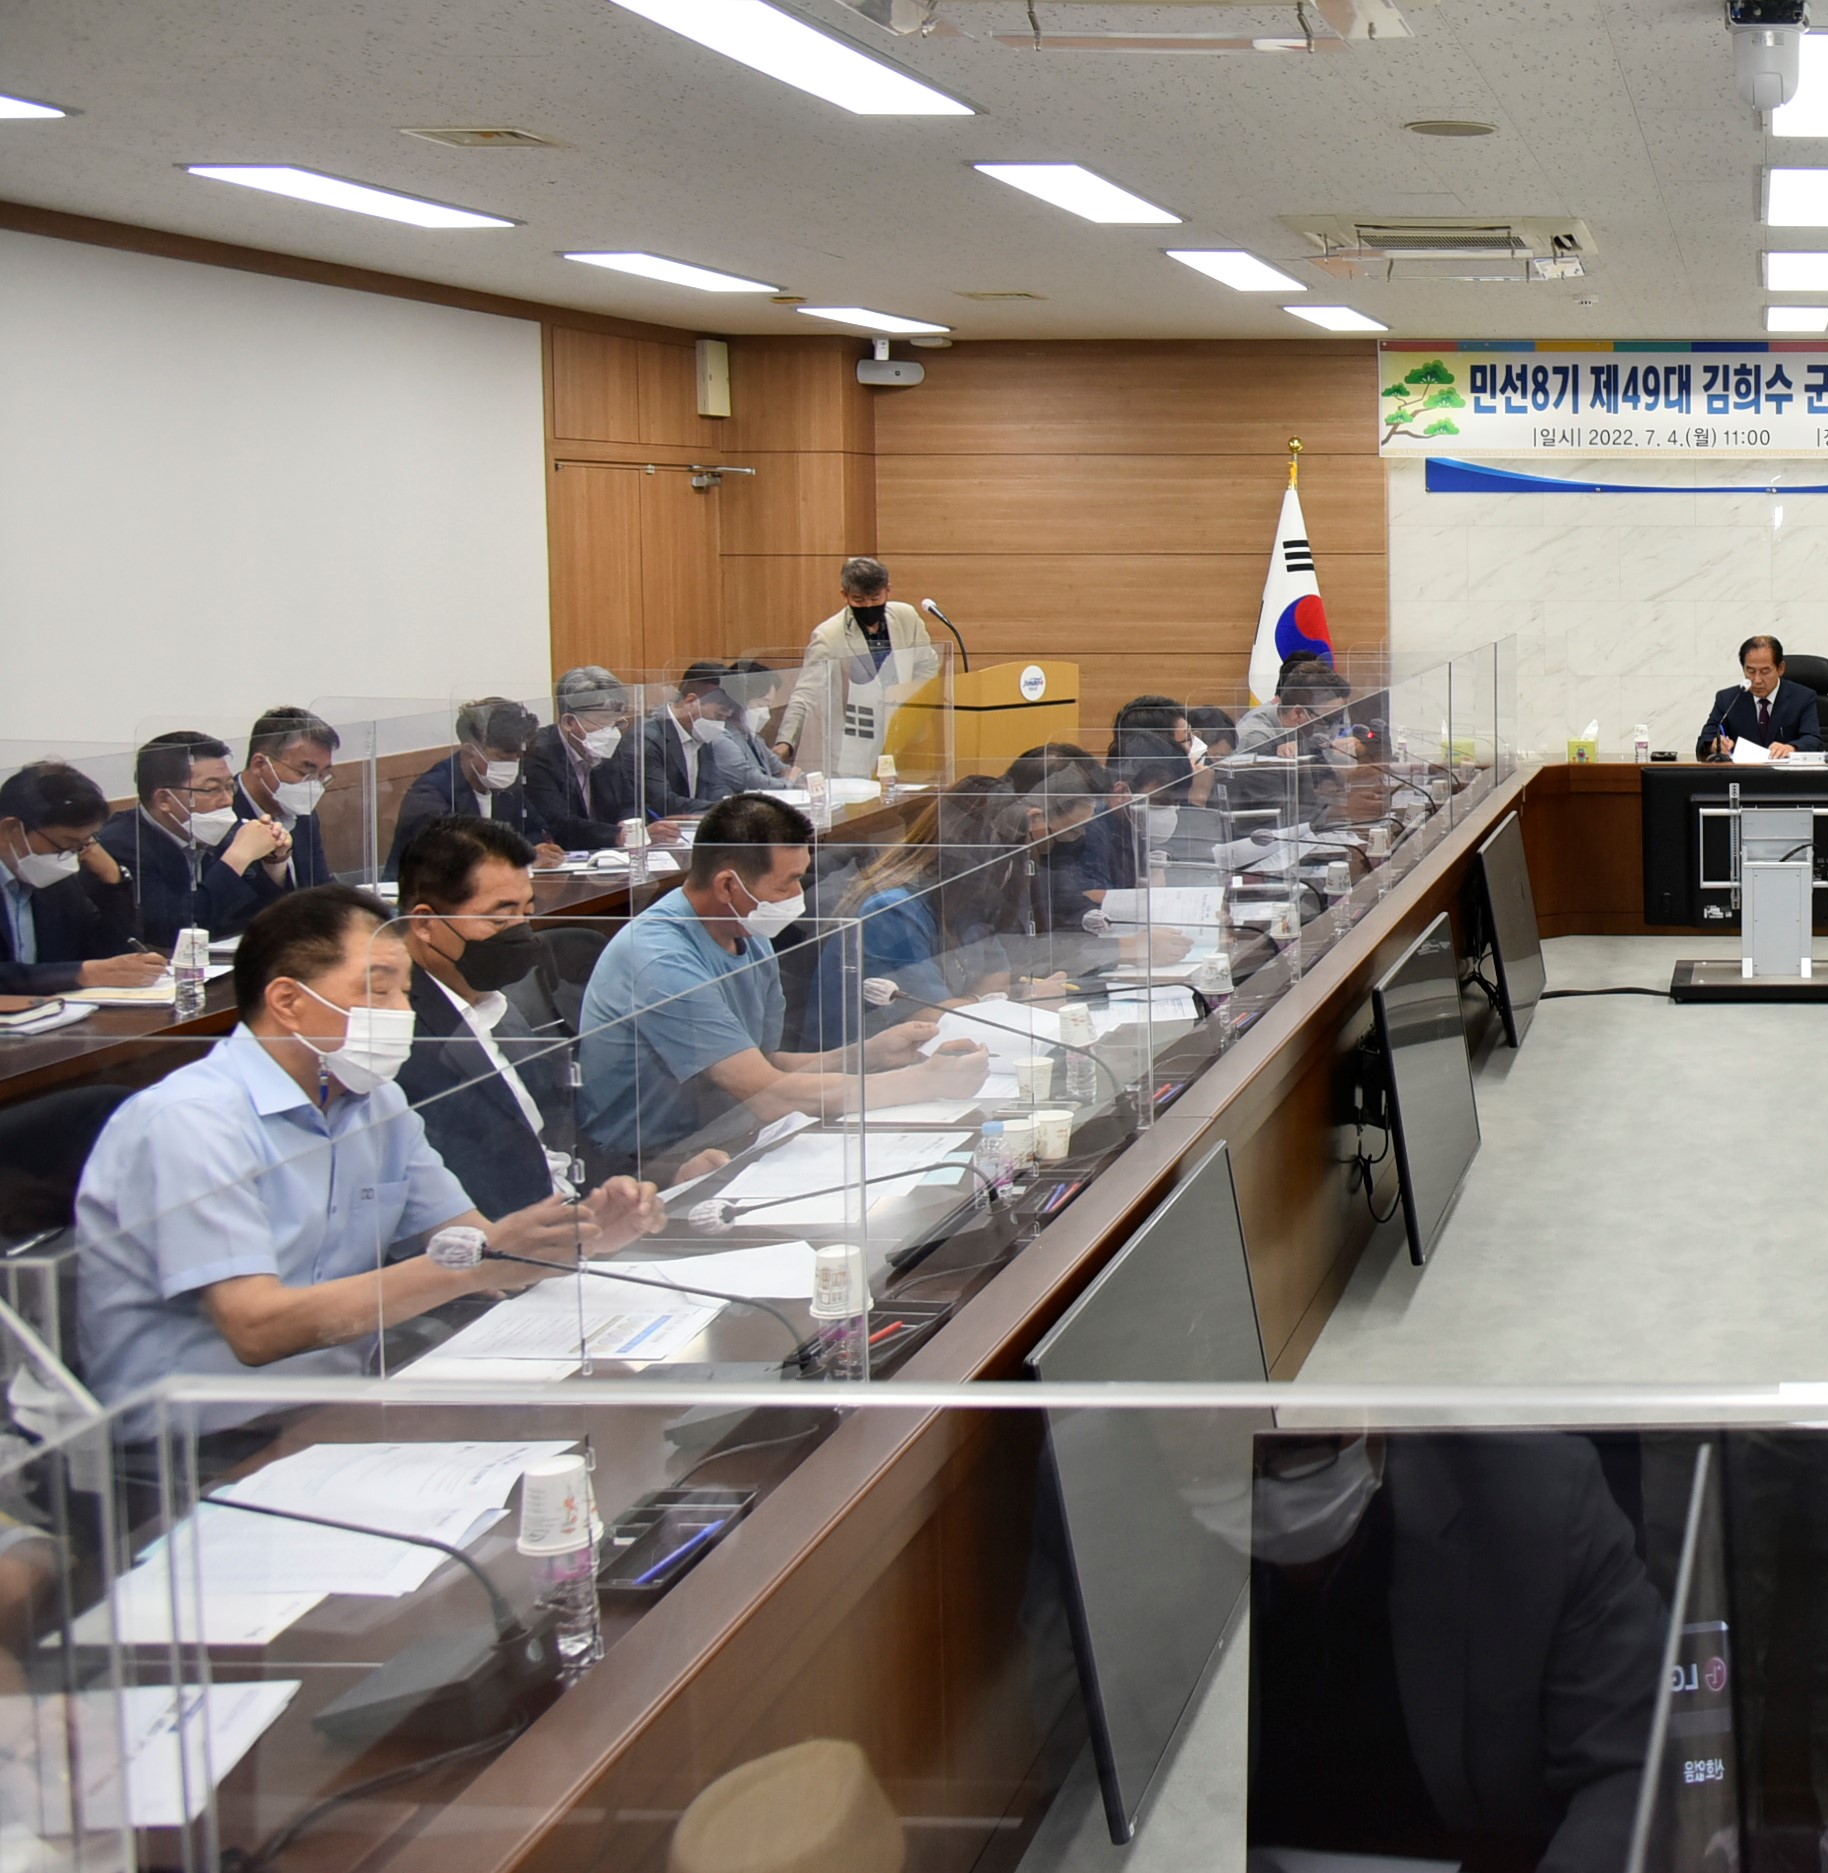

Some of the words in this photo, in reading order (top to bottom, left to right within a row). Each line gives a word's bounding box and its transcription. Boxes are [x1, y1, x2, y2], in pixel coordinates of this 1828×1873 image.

[1470, 364, 1579, 414] 민선8기
[1589, 364, 1692, 414] 제49대
[1702, 363, 1794, 414] 김희수
[1589, 429, 1639, 446] 2022.
[1645, 429, 1661, 446] 7.
[1667, 427, 1717, 447] 4.(월)
[1723, 429, 1771, 446] 11:00
